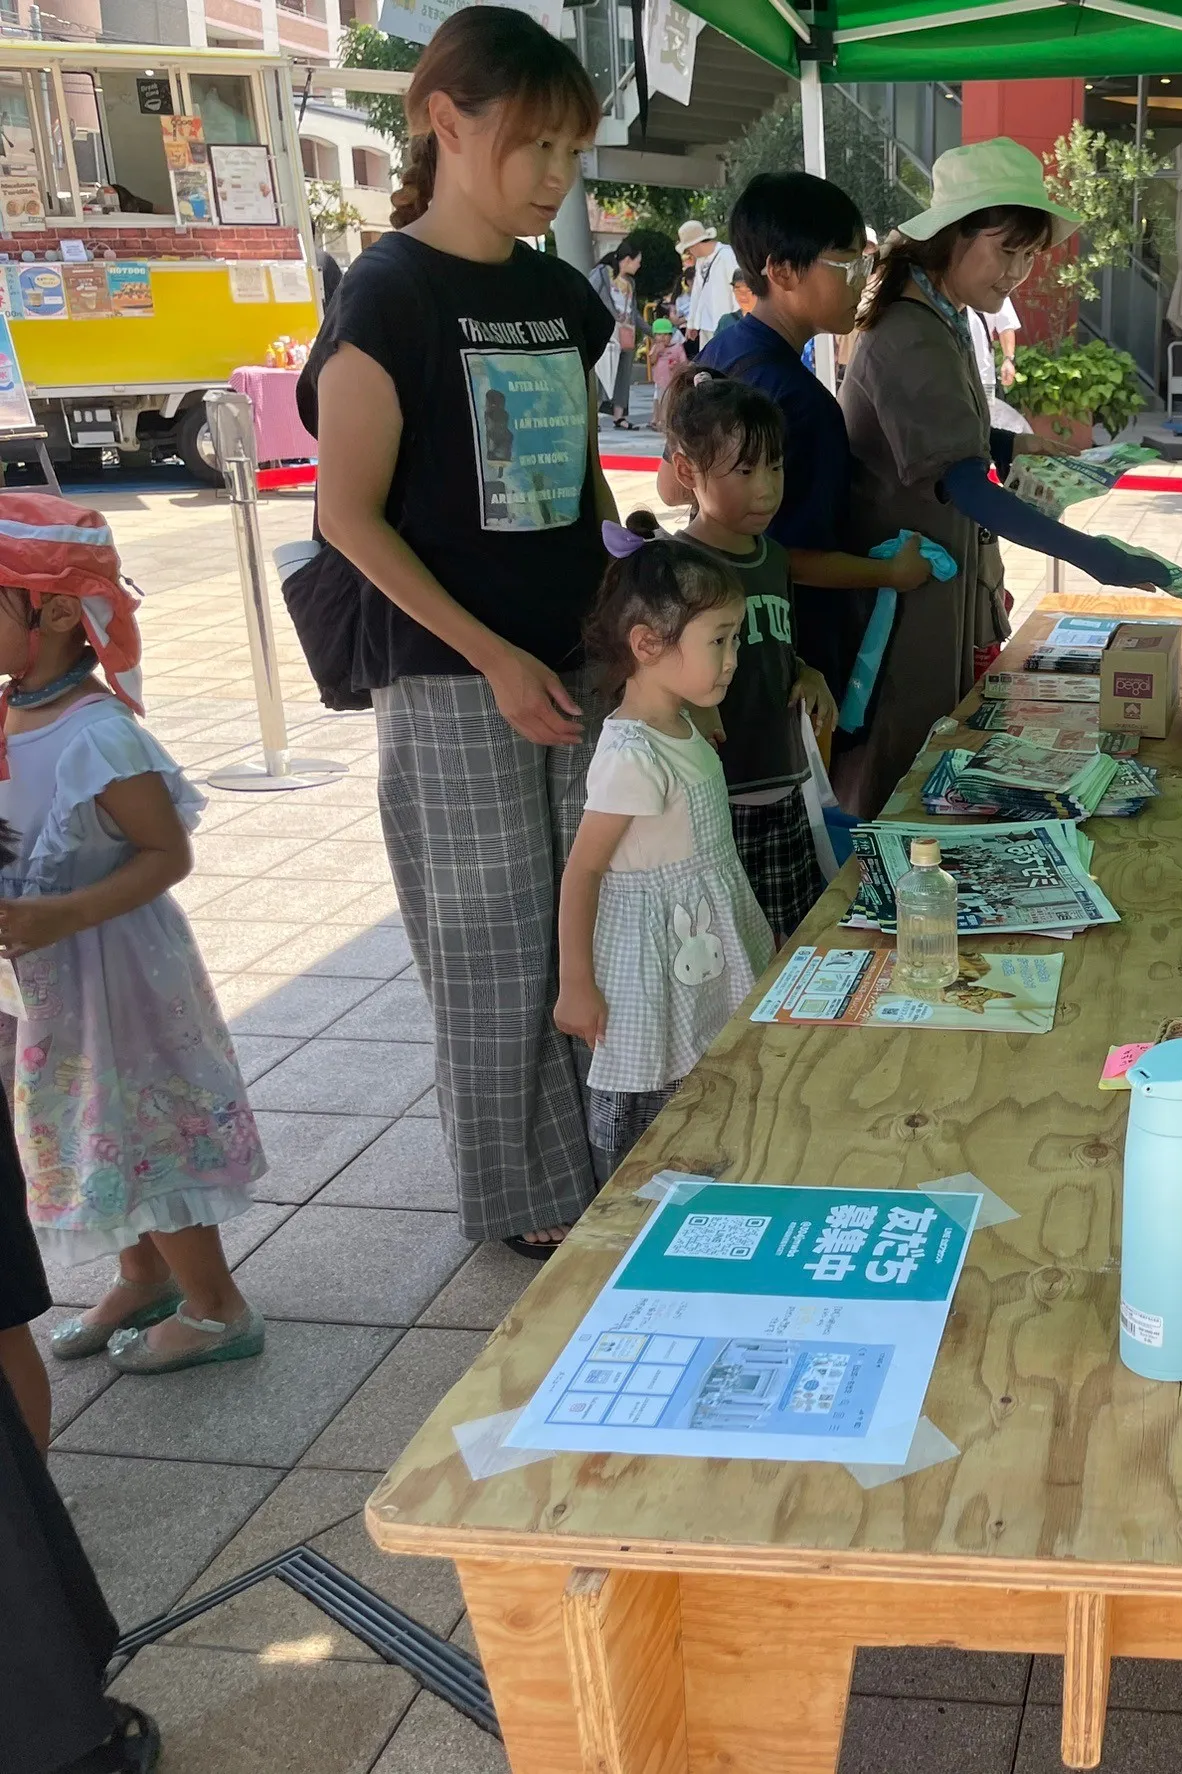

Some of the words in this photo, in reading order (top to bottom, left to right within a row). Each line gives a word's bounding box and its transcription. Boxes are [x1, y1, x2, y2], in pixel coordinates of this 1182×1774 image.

[524, 317, 570, 343] TODAY
[1003, 844, 1064, 887] まちゼミ
[803, 1203, 880, 1282] 募集中
[865, 1206, 938, 1284] 友だち
